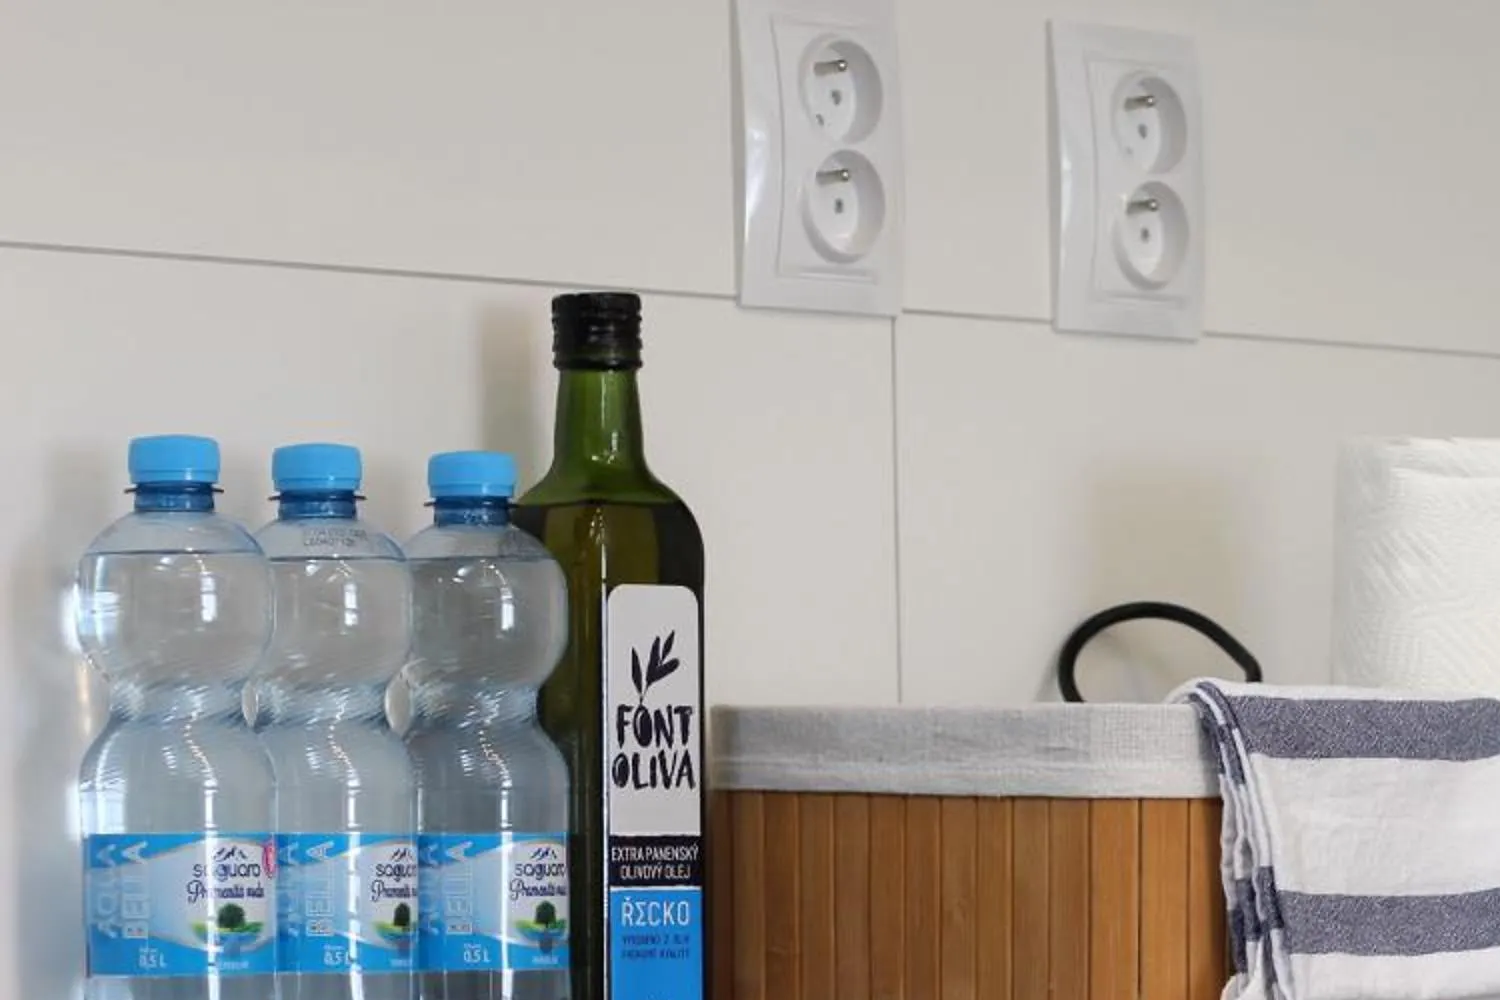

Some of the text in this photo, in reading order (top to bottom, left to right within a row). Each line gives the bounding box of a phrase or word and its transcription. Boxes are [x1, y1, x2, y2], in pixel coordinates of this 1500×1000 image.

[615, 702, 694, 749] FONT
[612, 749, 696, 790] OLIVA
[611, 846, 645, 862] EXTRA
